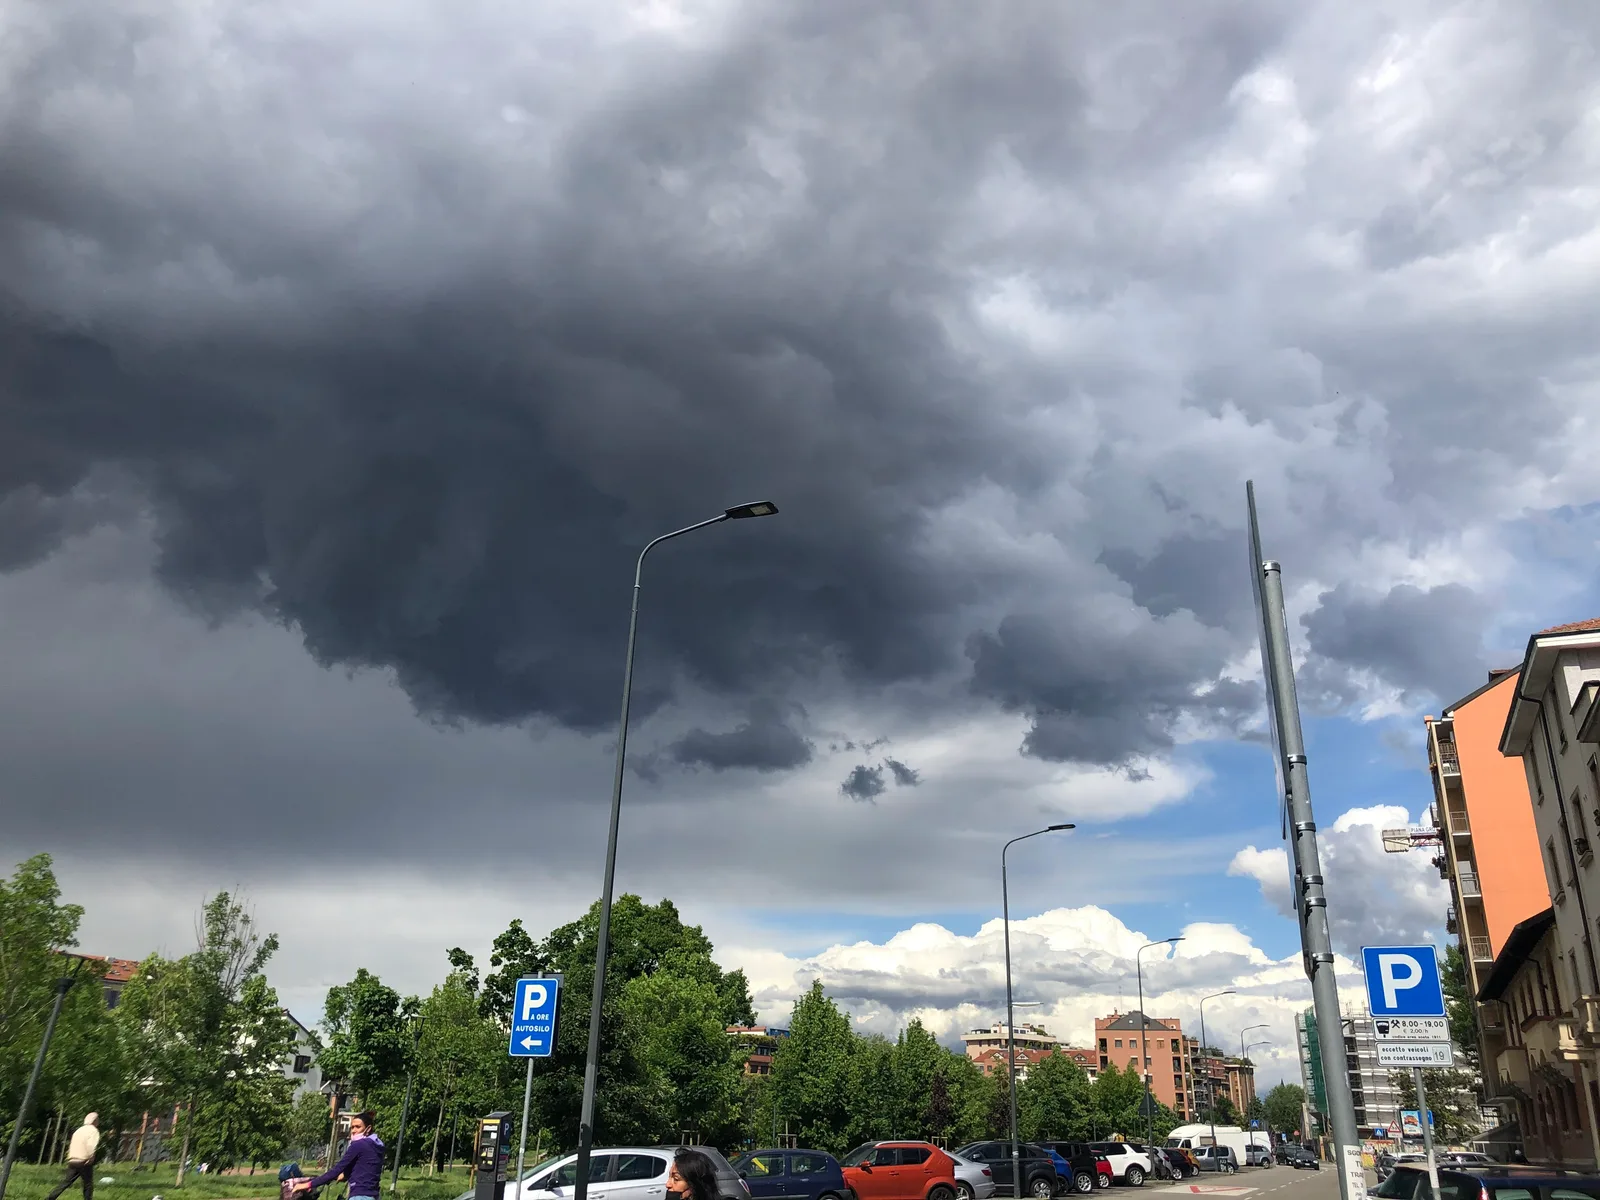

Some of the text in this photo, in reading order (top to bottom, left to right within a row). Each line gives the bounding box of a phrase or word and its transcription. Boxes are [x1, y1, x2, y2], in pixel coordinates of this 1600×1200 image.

[1378, 954, 1422, 1008] P
[522, 984, 547, 1020] P
[1434, 1051, 1444, 1060] 19
[504, 1123, 509, 1135] P
